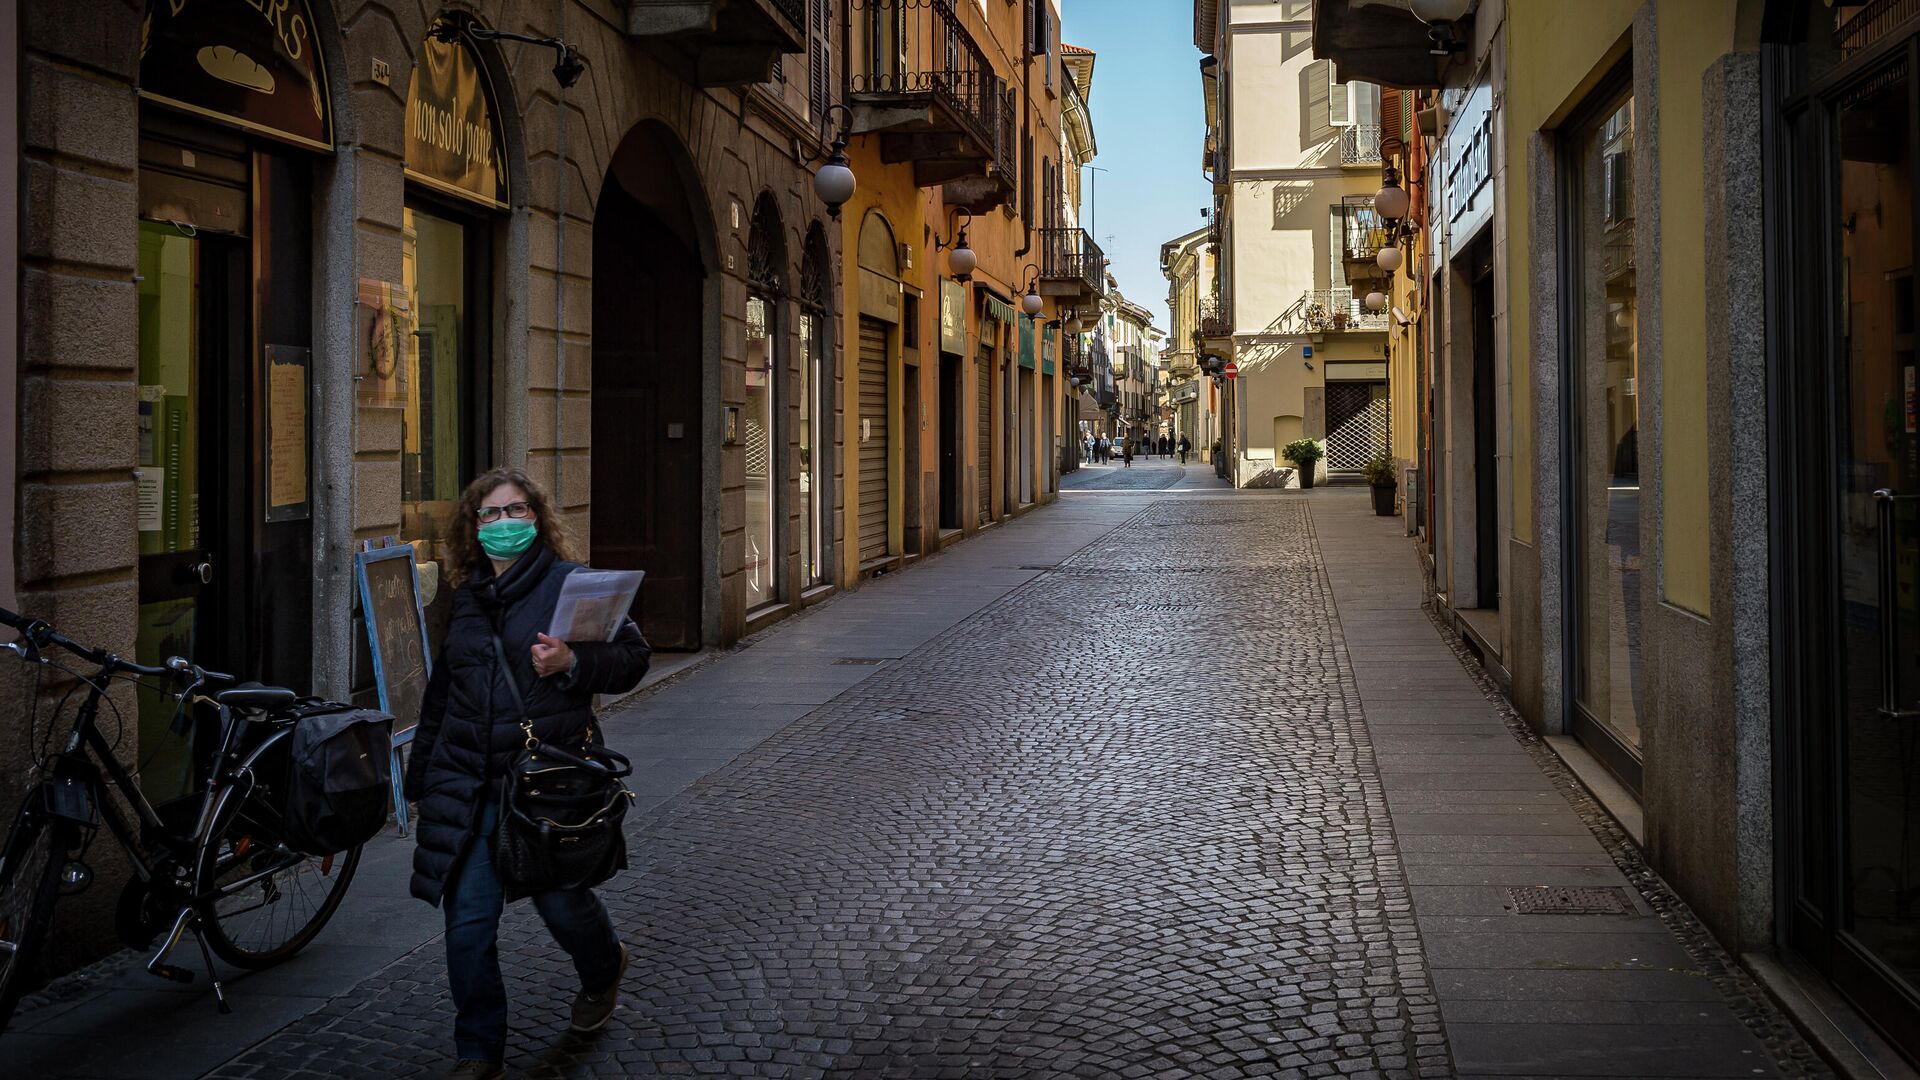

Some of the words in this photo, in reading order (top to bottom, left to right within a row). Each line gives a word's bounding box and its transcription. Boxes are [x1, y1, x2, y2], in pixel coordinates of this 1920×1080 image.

[413, 98, 436, 145] non
[439, 96, 463, 156] solo
[465, 121, 492, 178] pane
